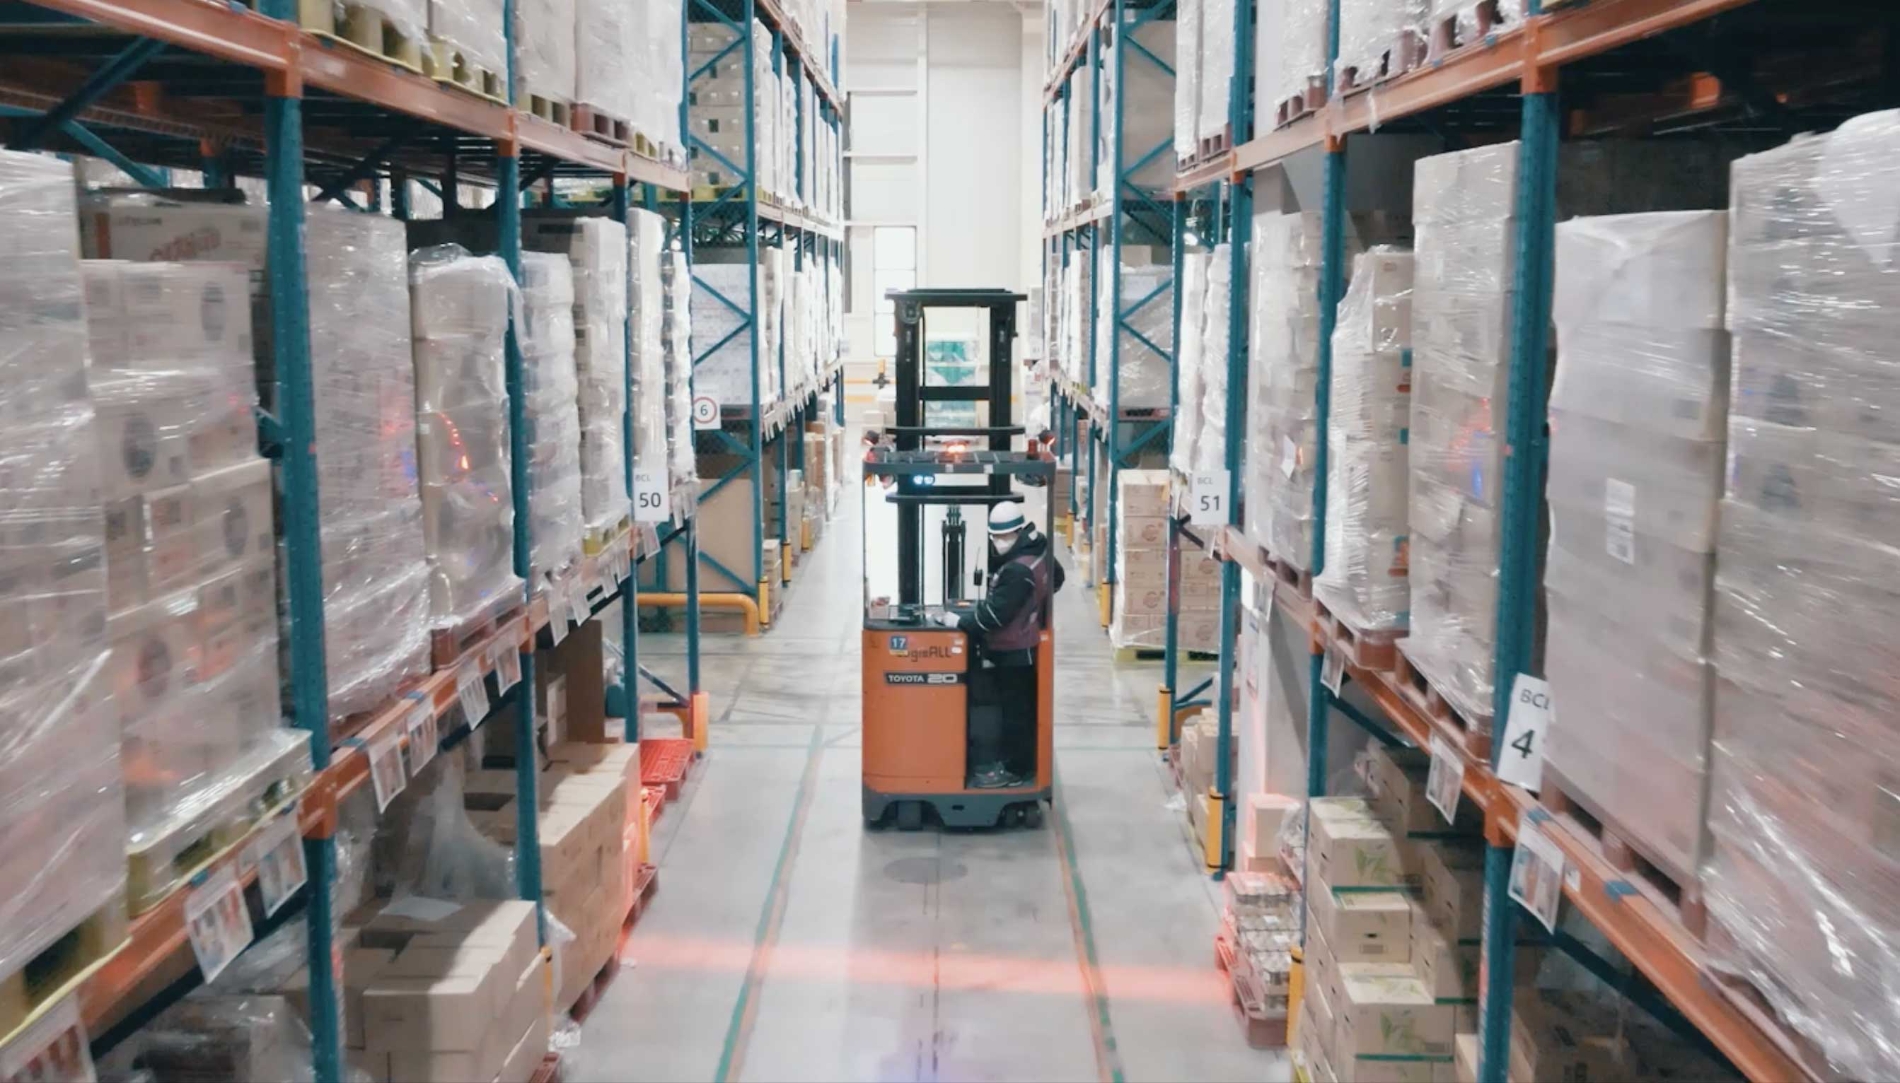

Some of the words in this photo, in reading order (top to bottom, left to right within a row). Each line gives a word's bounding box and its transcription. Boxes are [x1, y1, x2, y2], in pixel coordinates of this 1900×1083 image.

[700, 404, 708, 416] 6
[635, 474, 651, 482] BCL
[1197, 476, 1213, 485] BCL
[639, 492, 662, 508] 50
[1200, 495, 1220, 511] 51
[892, 637, 906, 649] 17
[888, 674, 925, 683] TOYOTA
[927, 673, 958, 684] 20
